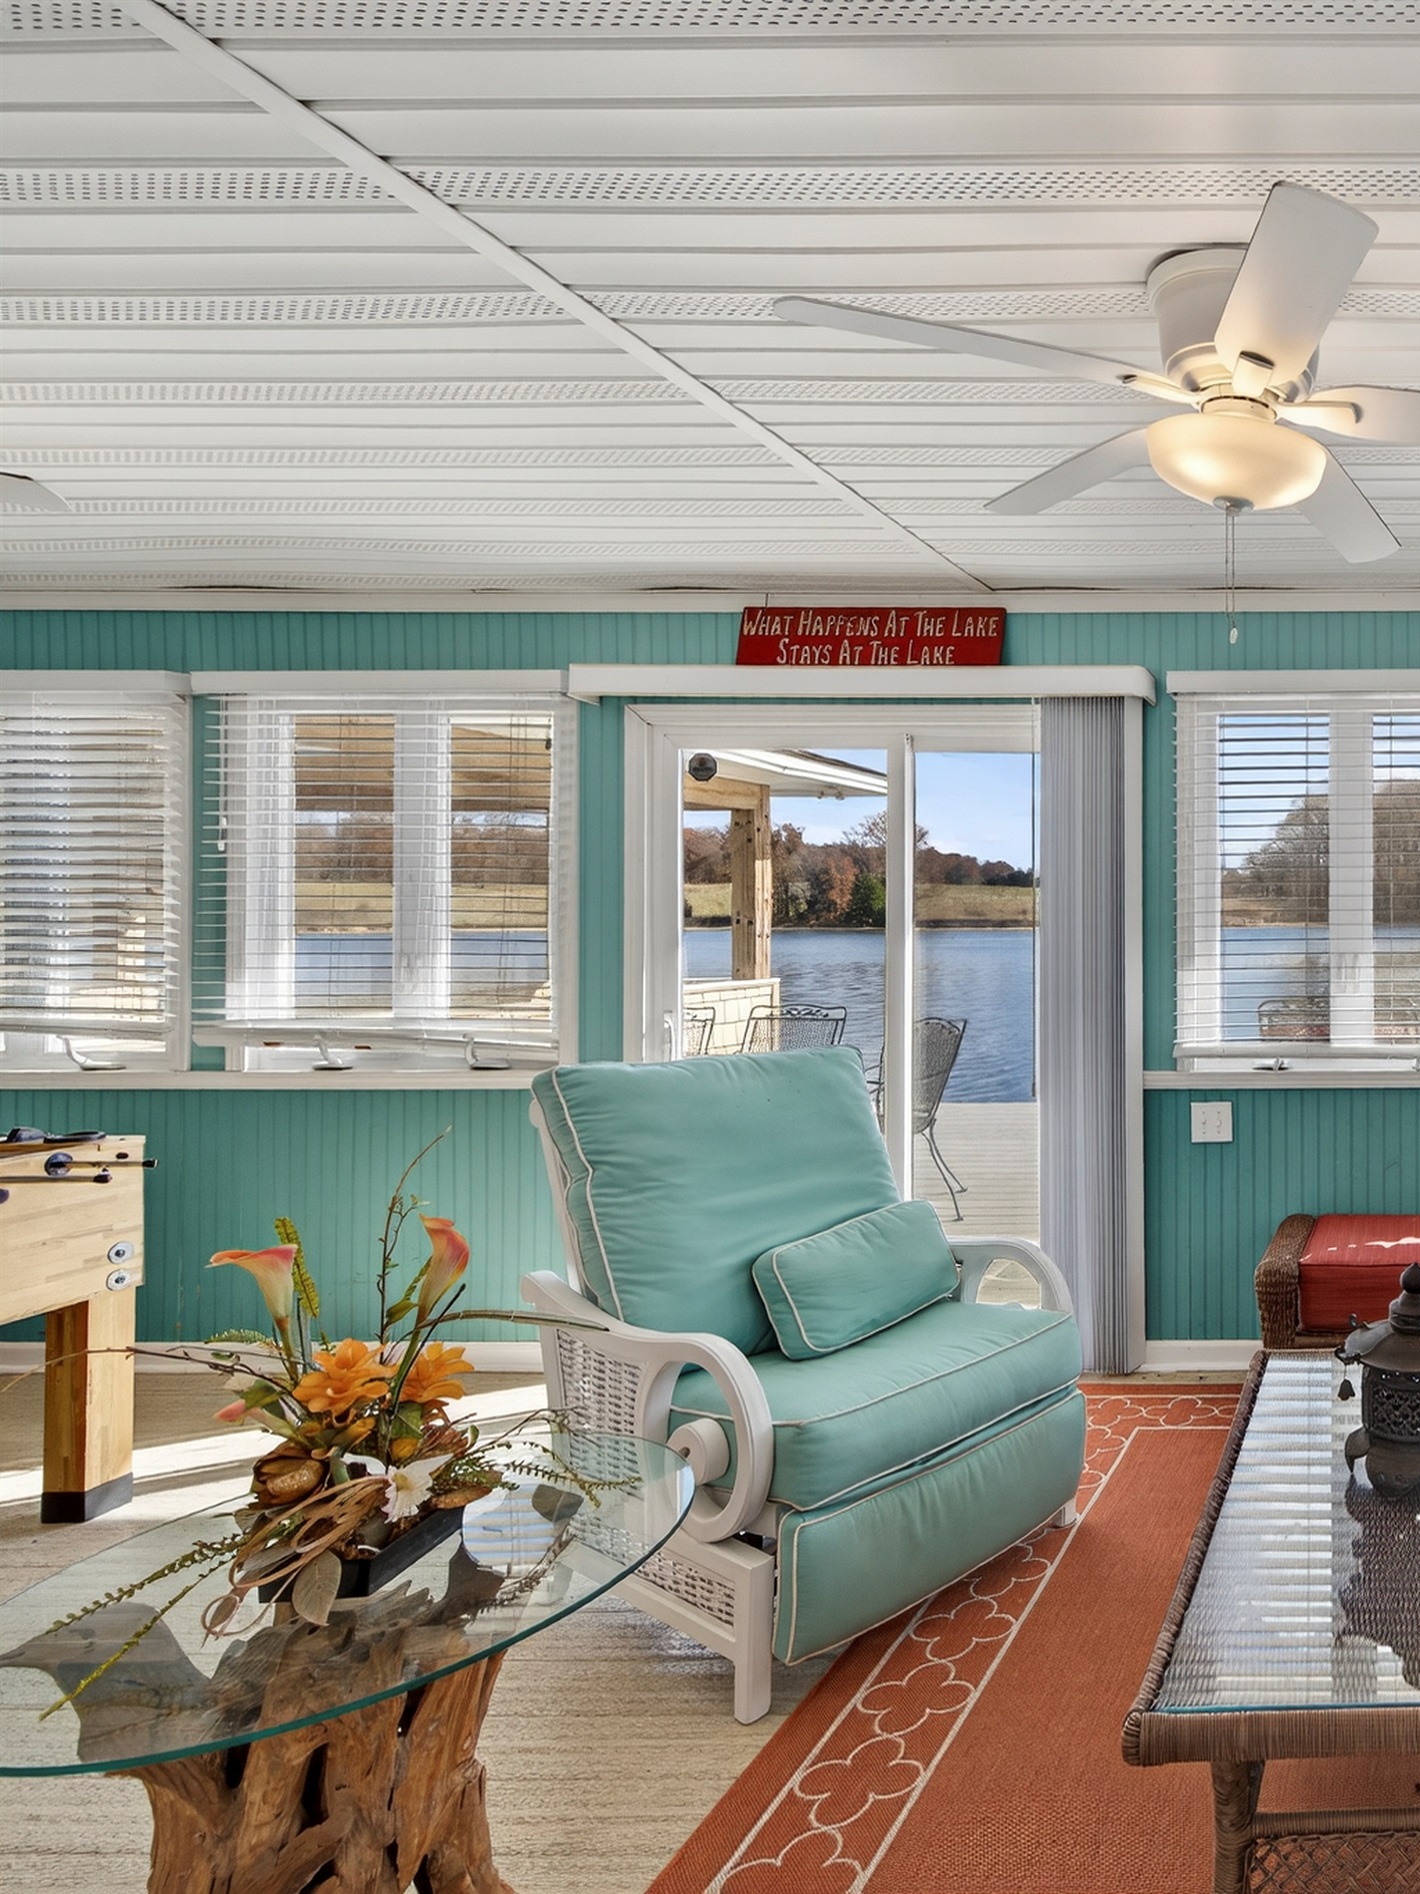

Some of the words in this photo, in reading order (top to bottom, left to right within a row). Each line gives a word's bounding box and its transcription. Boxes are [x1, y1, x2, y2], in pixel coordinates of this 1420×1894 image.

[743, 609, 794, 636] WHAT
[797, 610, 881, 637] HAPPENS
[883, 610, 910, 637] AT
[914, 610, 946, 637] THE
[952, 610, 999, 637] LAKE
[776, 638, 833, 665] STAYS
[838, 639, 863, 665] AT
[869, 640, 900, 665] THE
[906, 639, 955, 665] LAKE
